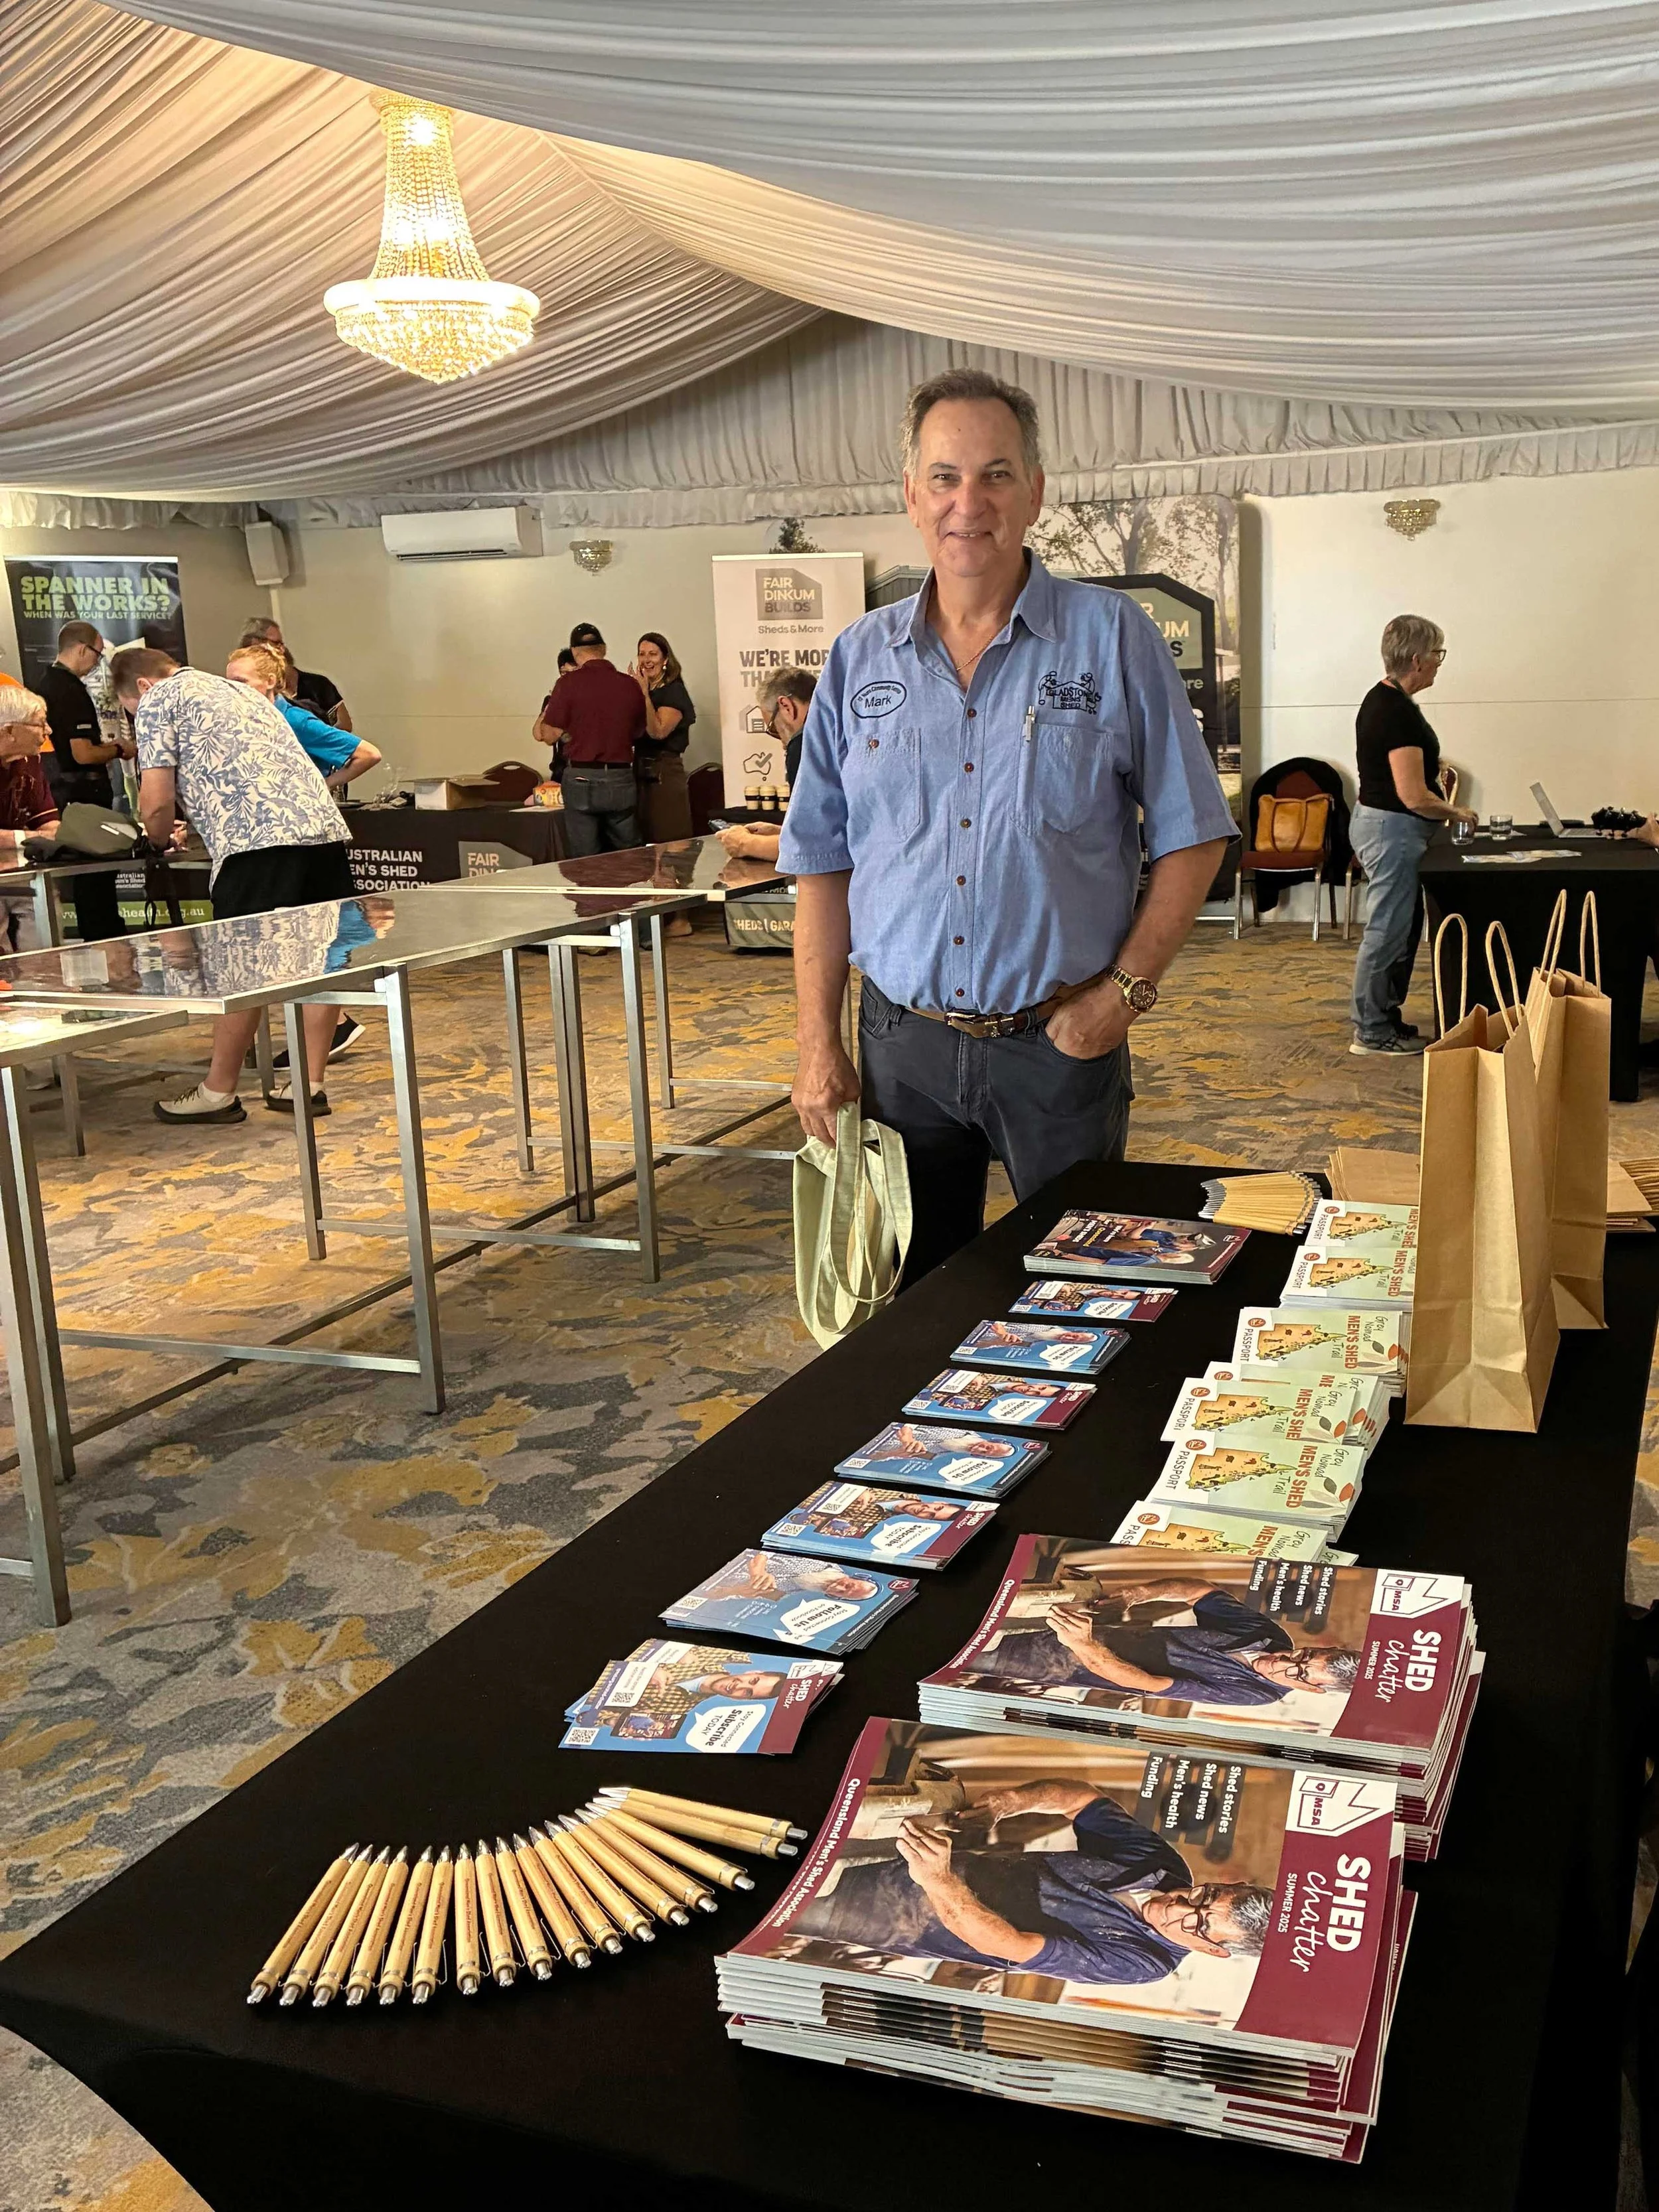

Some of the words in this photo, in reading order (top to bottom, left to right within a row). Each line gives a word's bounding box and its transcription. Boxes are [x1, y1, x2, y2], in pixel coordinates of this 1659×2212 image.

[21, 576, 133, 594] SPANNER
[142, 577, 169, 594] IN
[763, 577, 792, 588] FAIR
[23, 594, 65, 610] THE
[72, 594, 171, 611] WORKS?
[764, 589, 815, 600] DINKUM
[132, 611, 171, 620] SERVICE?
[764, 602, 811, 613] BUILDS
[758, 625, 789, 634] Sheds
[798, 624, 824, 633] More
[739, 649, 790, 667] WE'RE
[865, 695, 892, 709] Mark
[346, 849, 423, 863] USTRALIAN
[467, 853, 500, 866] FAIR
[381, 865, 418, 877] SHED
[1314, 1214, 1329, 1240] PASSPORT
[1392, 1250, 1407, 1274] MEN'S
[1293, 1262, 1308, 1288] PASSPORT
[1388, 1276, 1403, 1296] SHED
[1346, 1315, 1361, 1343] MEN'S
[1362, 1321, 1374, 1342] Nomad
[1373, 1316, 1388, 1332] Grey
[1240, 1328, 1254, 1362] PASSPORT
[1331, 1342, 1344, 1359] Trail
[1344, 1343, 1359, 1369] SHED
[1293, 1389, 1314, 1418] MEN'S
[1311, 1395, 1327, 1417] Nomad
[1324, 1391, 1342, 1407] Grey
[1272, 1417, 1289, 1433] Trail
[1295, 1445, 1318, 1478] MEN'S
[1314, 1454, 1333, 1478] Nomad
[1332, 1448, 1349, 1468] Grey
[1166, 1451, 1190, 1490] PASSPORT
[1272, 1476, 1291, 1495] Trail
[1285, 1479, 1307, 1509] SHED
[885, 1525, 922, 1547] Subscribe
[1268, 1535, 1290, 1558] Nomad
[1287, 1531, 1311, 1548] Grey
[1250, 1560, 1267, 1591] Funding
[1277, 1562, 1290, 1588] Men's
[1300, 1564, 1313, 1585] Shed
[1321, 1566, 1333, 1586] Shed
[989, 1579, 1015, 1618] Queensland
[1269, 1587, 1284, 1612] health
[1295, 1585, 1308, 1606] news
[1314, 1586, 1327, 1616] stories
[807, 1604, 842, 1622] Follow
[970, 1633, 987, 1646] Shed
[1367, 1641, 1380, 1666] SUMMER
[1404, 1629, 1442, 1692] SHED
[1364, 1666, 1374, 1680] 2025
[1374, 1639, 1405, 1703] chatter
[783, 1683, 798, 1709] chatter
[795, 1679, 812, 1702] SHED
[701, 1715, 723, 1736] TODAY
[705, 1709, 743, 1746] Subscribe
[1141, 1756, 1163, 1799] Funding
[1175, 1759, 1190, 1789] Men's
[1201, 1763, 1218, 1791] Shed
[1226, 1765, 1242, 1793] Shed
[830, 1778, 861, 1839] Queensland
[1165, 1789, 1182, 1829] health
[1195, 1791, 1210, 1821] news
[1218, 1792, 1236, 1834] stories
[815, 1838, 838, 1866] Men's
[804, 1865, 824, 1888] Shed
[1282, 1872, 1298, 1912] SUMMER
[1327, 1853, 1372, 1953] SHED
[771, 1886, 810, 1927] Association
[1277, 1912, 1291, 1933] 2025
[1289, 1871, 1334, 1974] chatter
